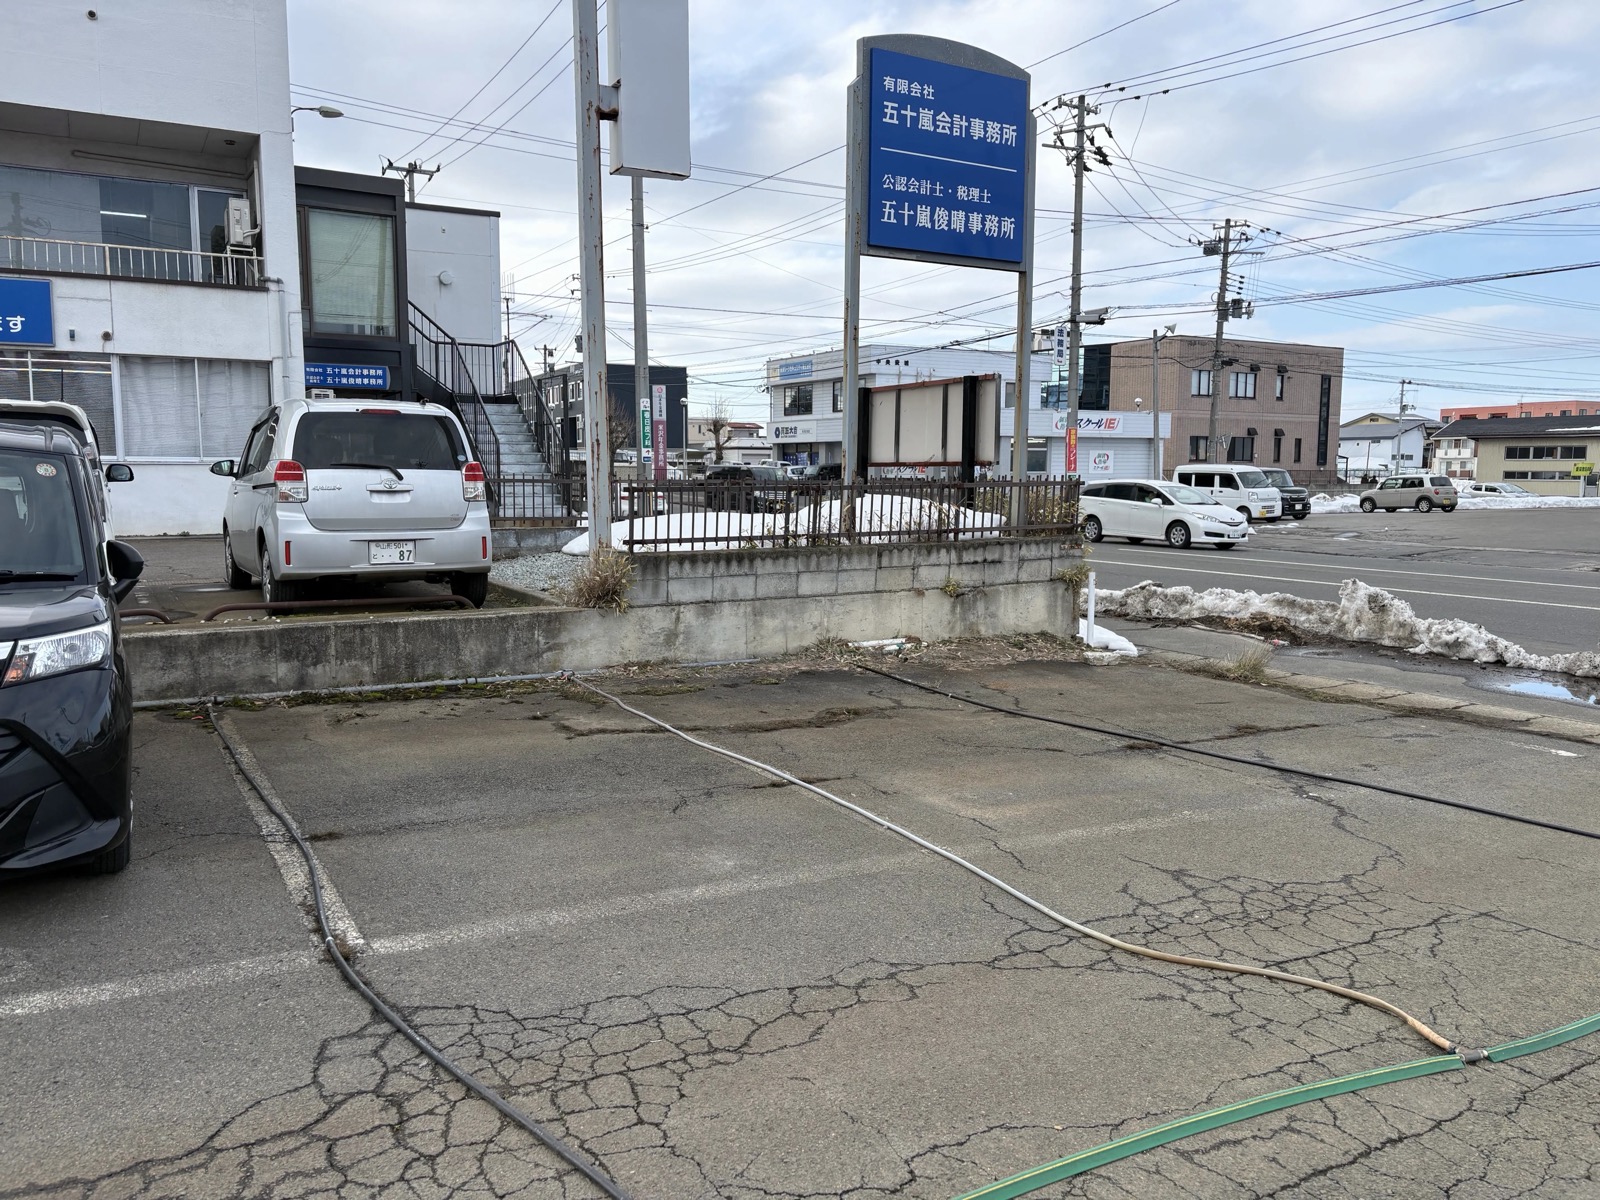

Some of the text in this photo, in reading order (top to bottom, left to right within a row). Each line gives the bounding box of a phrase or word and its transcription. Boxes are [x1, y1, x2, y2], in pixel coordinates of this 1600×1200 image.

[883, 76, 935, 100] 有限会社
[882, 101, 1017, 147] 五十嵐会計事務所
[882, 174, 991, 204] 公認会計士・税理士
[880, 200, 1015, 240] 五十嵐俊晴事務所
